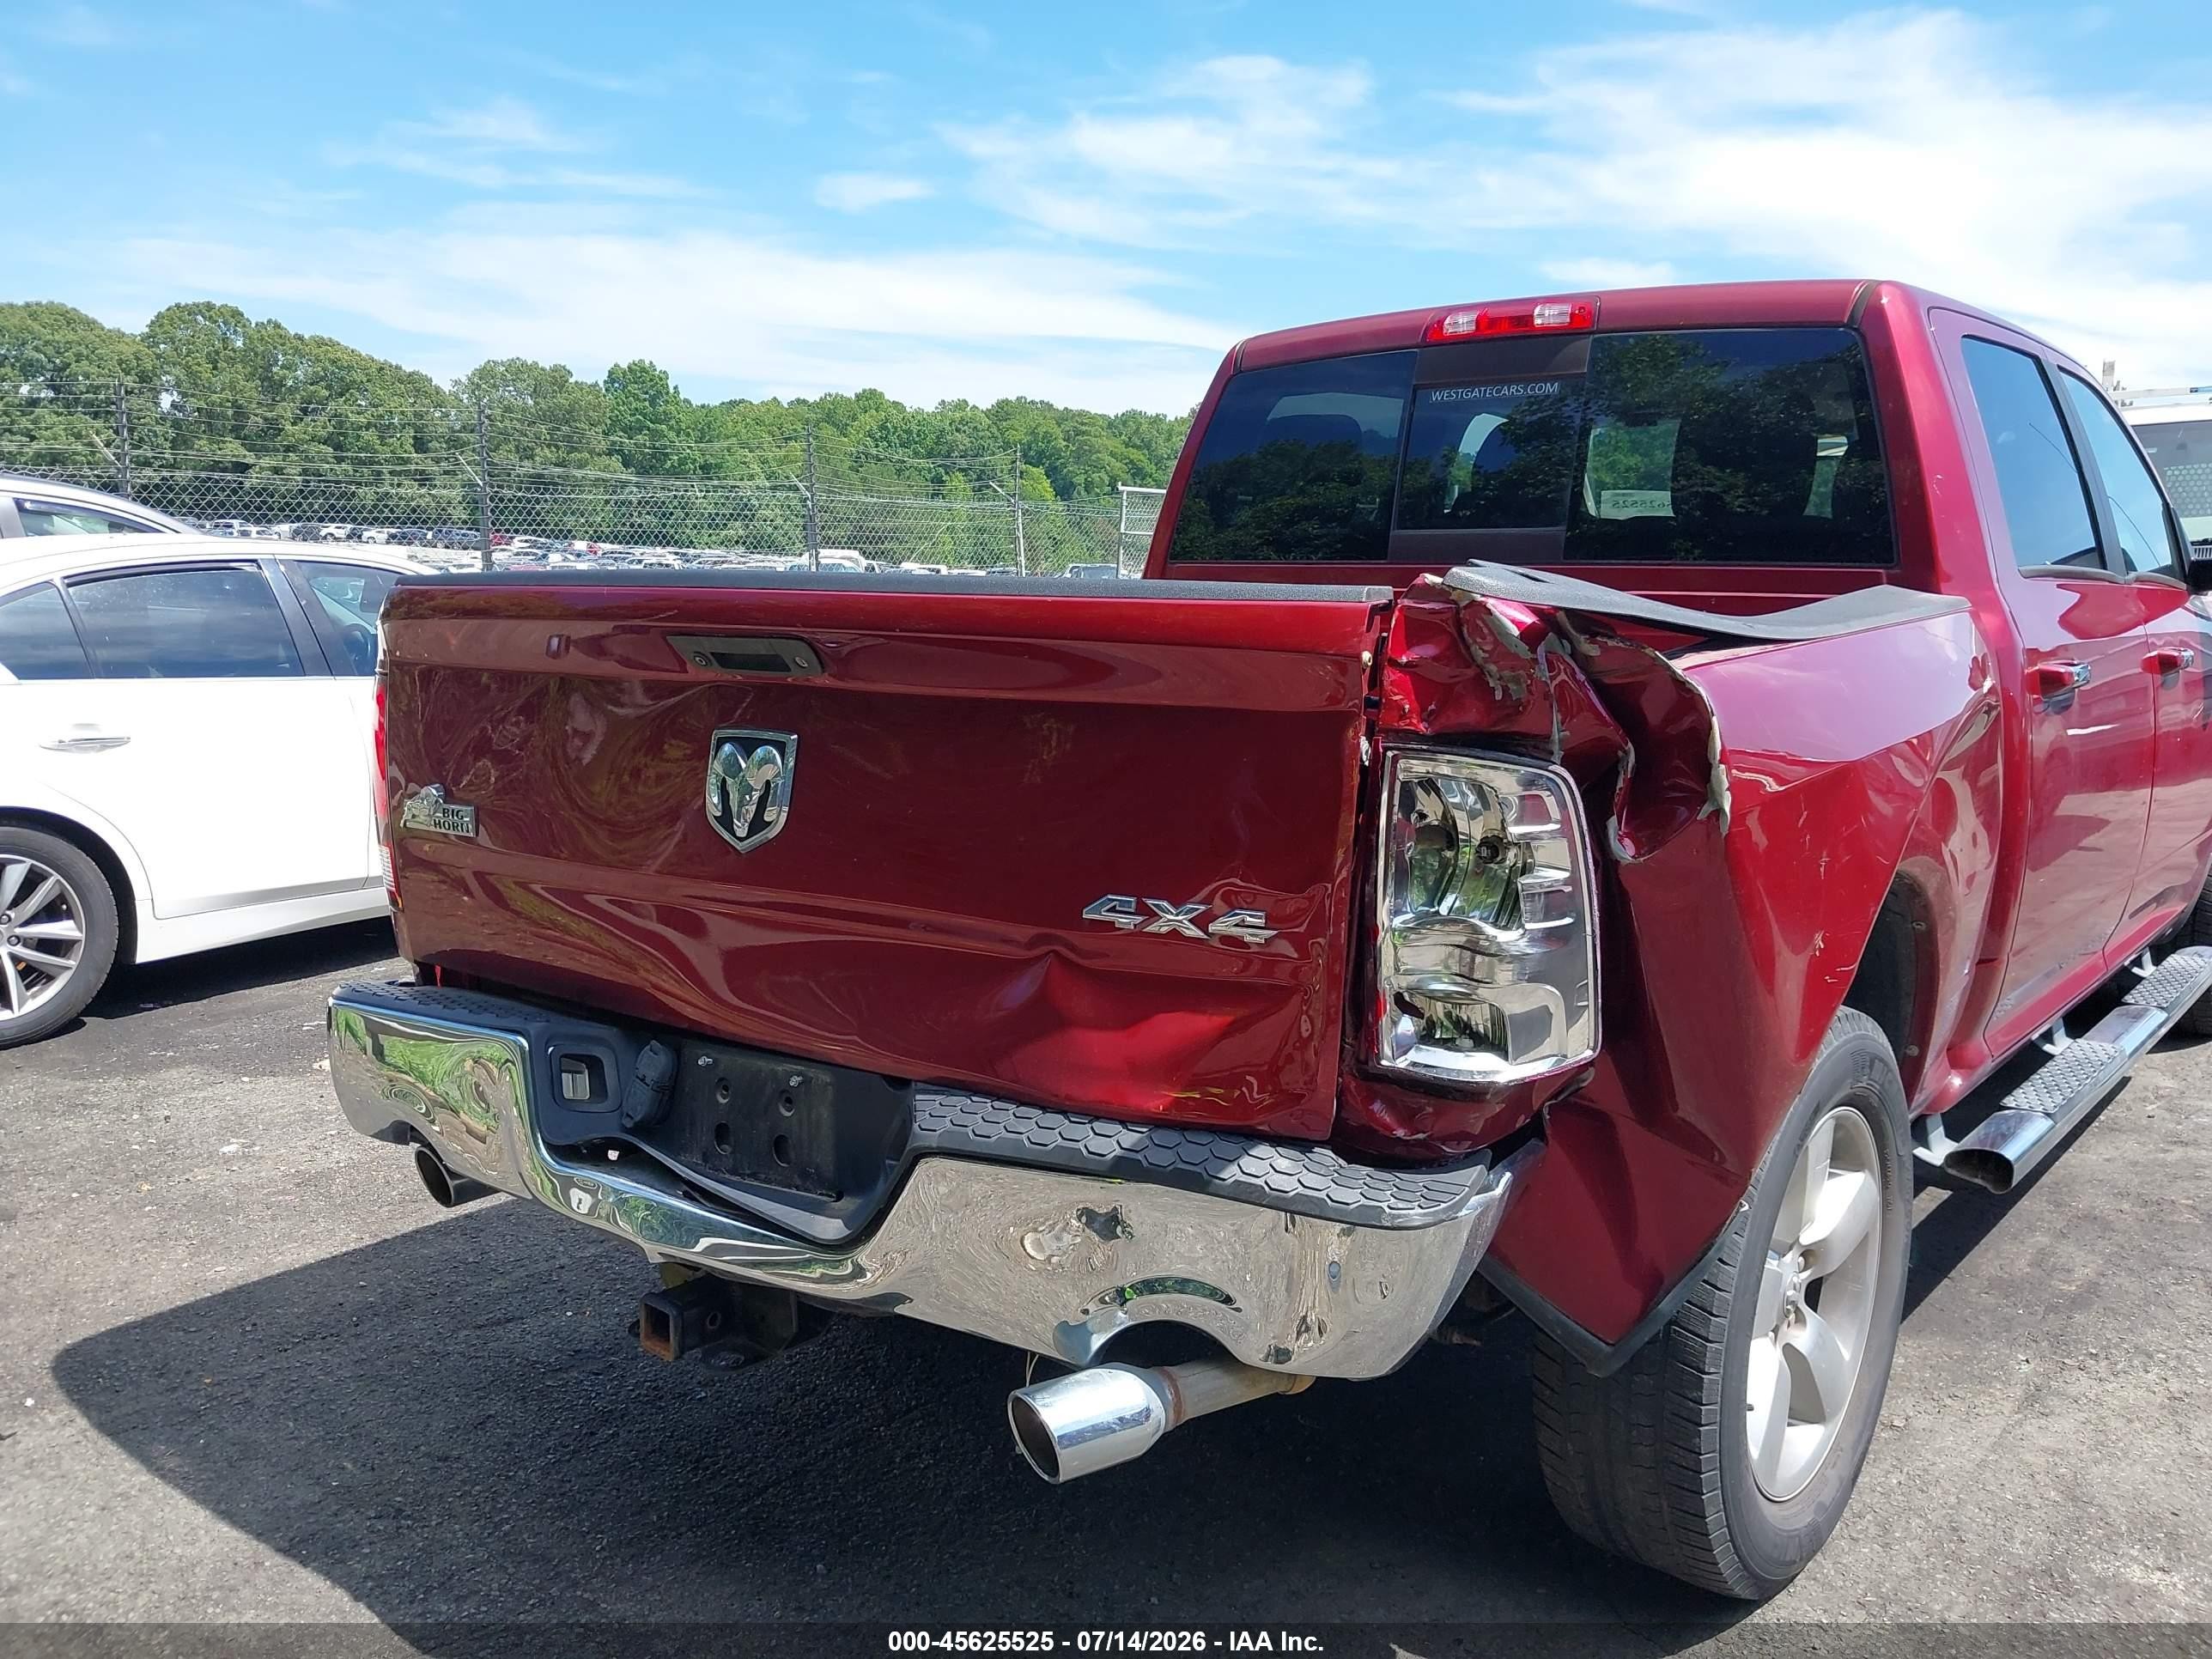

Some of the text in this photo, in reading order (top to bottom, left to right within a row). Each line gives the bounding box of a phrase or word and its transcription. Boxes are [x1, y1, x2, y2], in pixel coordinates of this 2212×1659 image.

[1431, 381, 1559, 402] WESTGATECARS.COM
[442, 808, 465, 820] BIG
[433, 819, 470, 833] HORN
